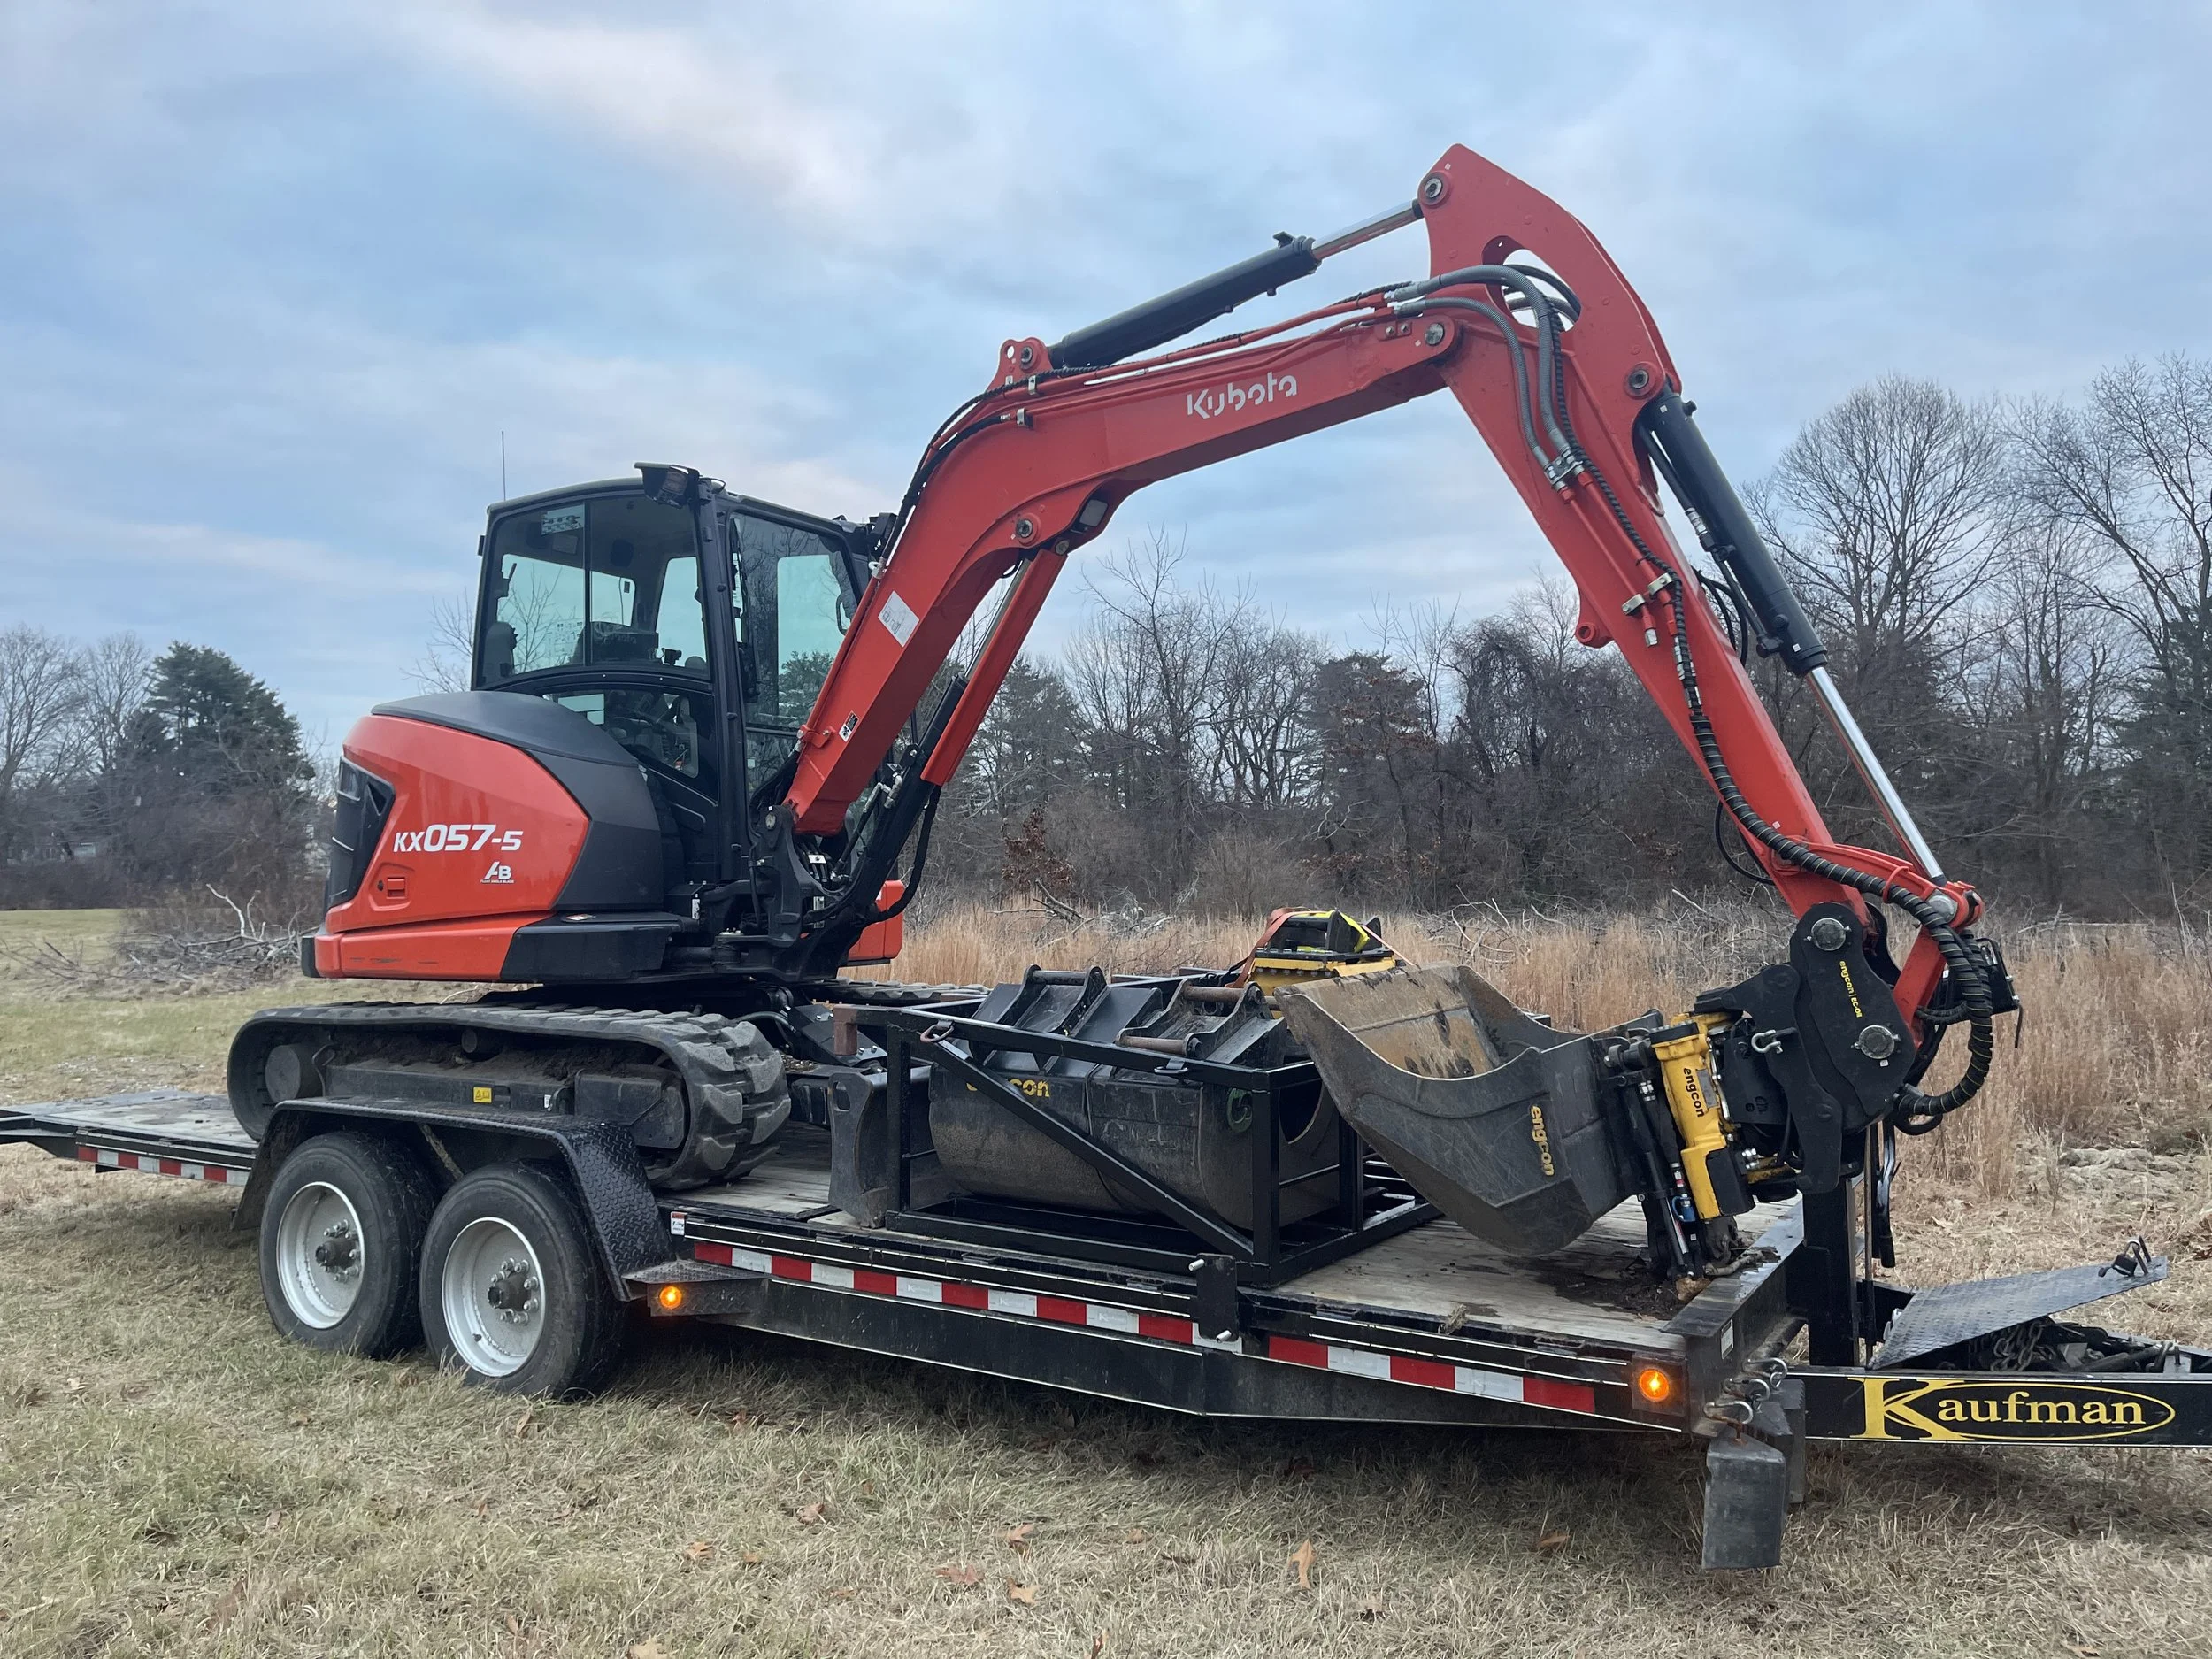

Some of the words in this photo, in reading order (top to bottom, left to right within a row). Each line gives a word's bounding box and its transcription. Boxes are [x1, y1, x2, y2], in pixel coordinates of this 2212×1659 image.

[1187, 372, 1298, 419] Kubota
[393, 824, 524, 852] KX057-5
[1839, 960, 1855, 994] engcon
[1684, 1067, 1705, 1118] engcon
[1530, 1105, 1555, 1176] engcon
[1847, 1377, 2147, 1441] Kaufman
